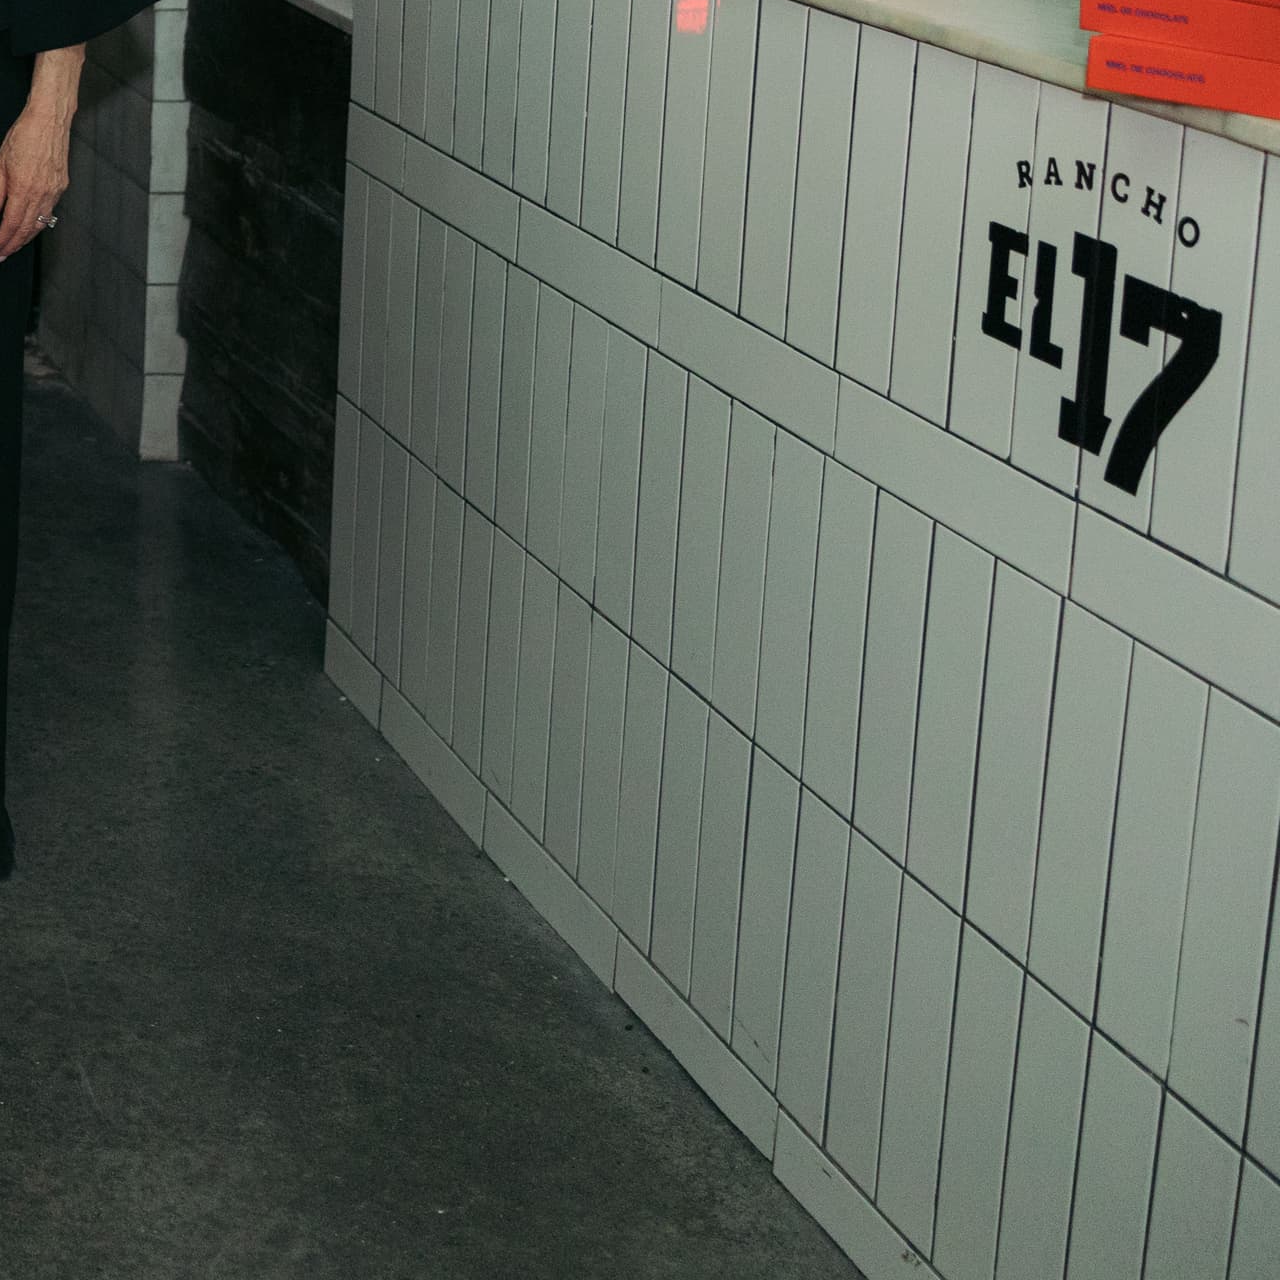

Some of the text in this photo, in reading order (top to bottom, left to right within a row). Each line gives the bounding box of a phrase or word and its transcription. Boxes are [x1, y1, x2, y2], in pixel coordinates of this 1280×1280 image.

[1016, 156, 1200, 248] RANCHO
[981, 220, 1223, 497] EL 17
